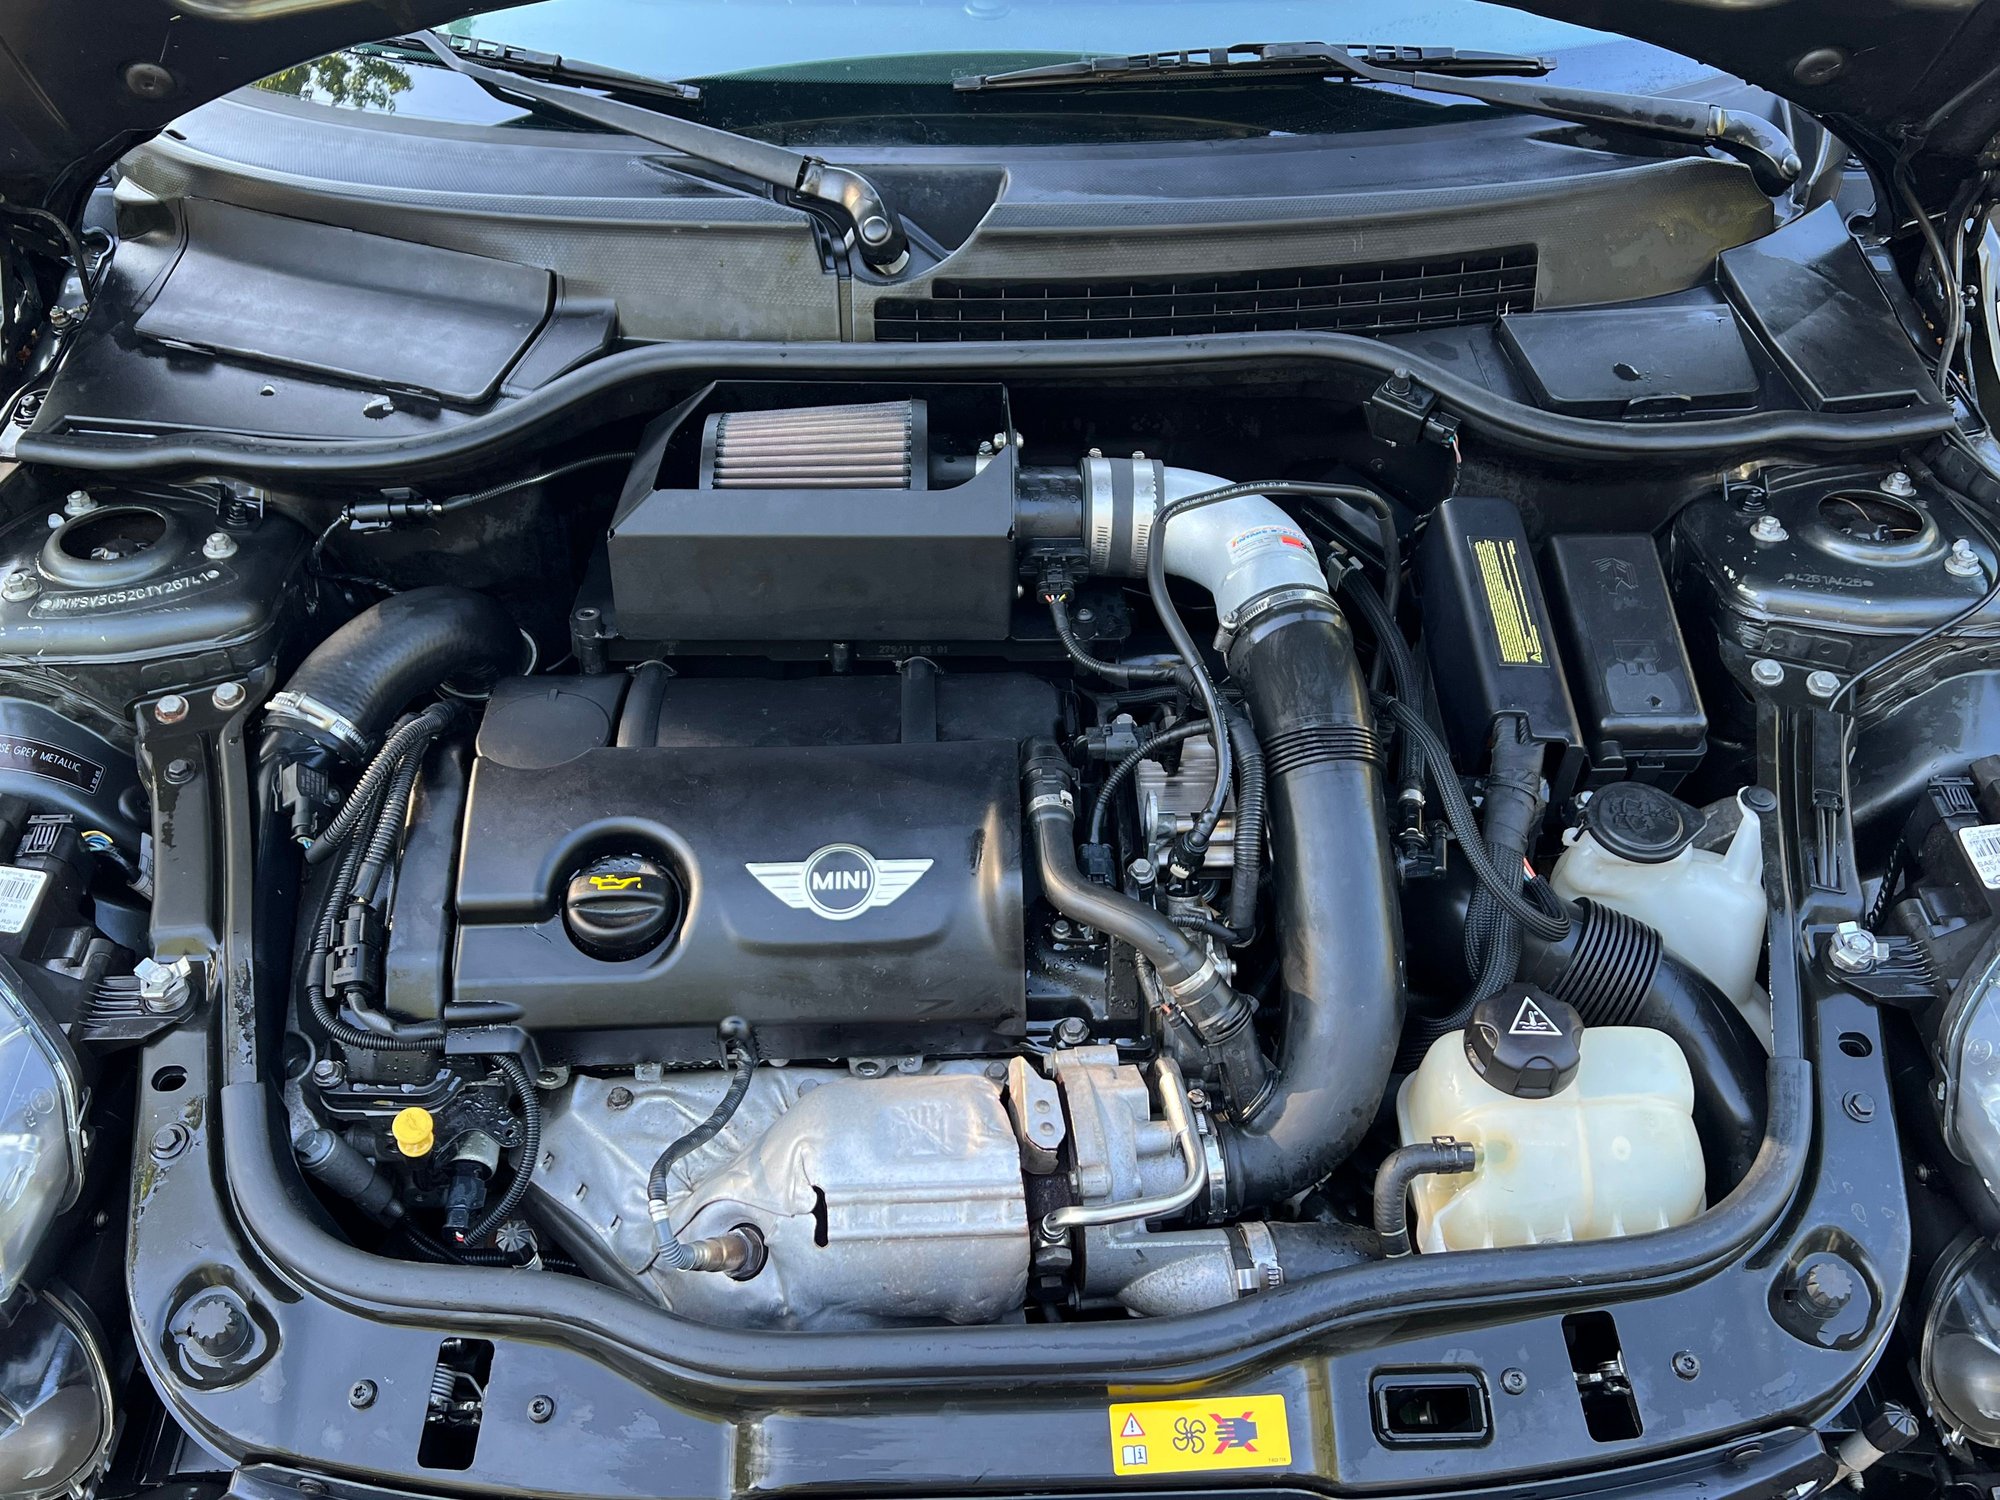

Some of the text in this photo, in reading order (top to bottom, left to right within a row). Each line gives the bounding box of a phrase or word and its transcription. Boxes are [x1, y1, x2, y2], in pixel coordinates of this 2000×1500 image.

[13, 745, 38, 758] GREY
[40, 751, 81, 773] METALLIC
[812, 870, 869, 891] MINI
